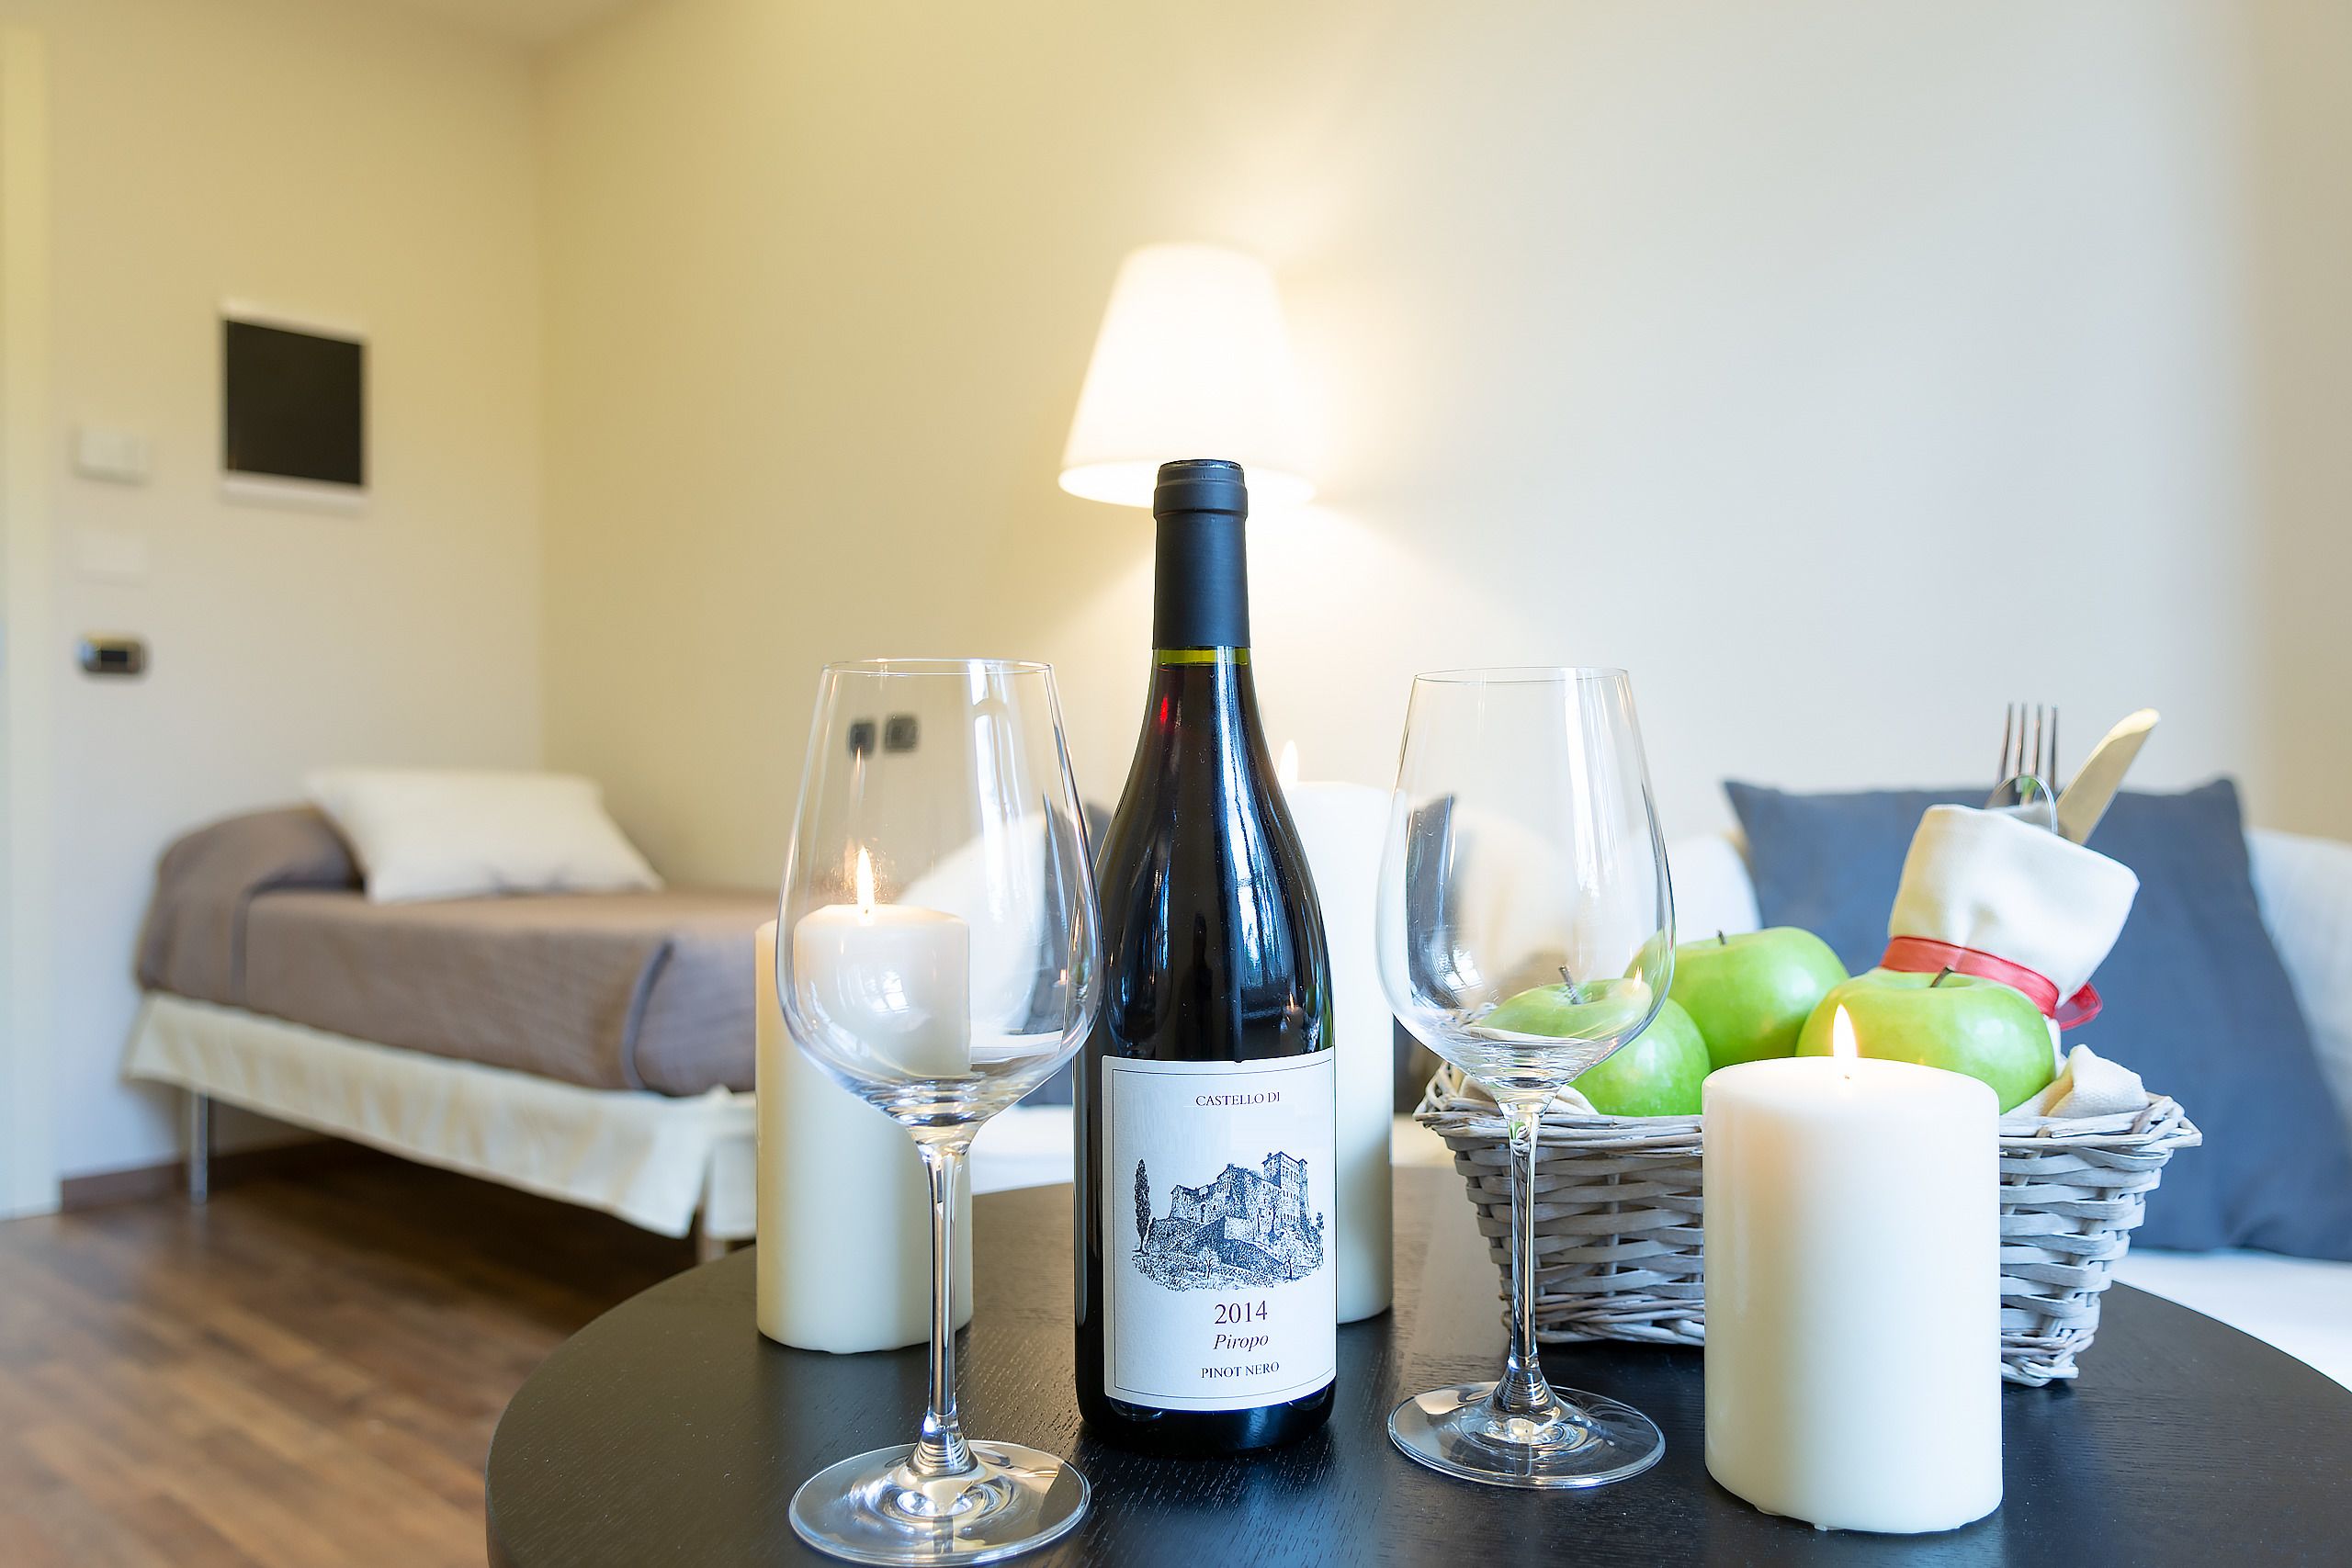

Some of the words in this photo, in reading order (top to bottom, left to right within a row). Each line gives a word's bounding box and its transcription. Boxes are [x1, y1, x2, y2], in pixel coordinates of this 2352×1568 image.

[1195, 1093, 1264, 1107] CASTELLO
[1268, 1091, 1280, 1102] DI
[1214, 1300, 1268, 1325] 2014
[1213, 1334, 1269, 1351] Piropo
[1202, 1366, 1241, 1378] PINOT
[1245, 1361, 1280, 1376] NERO
